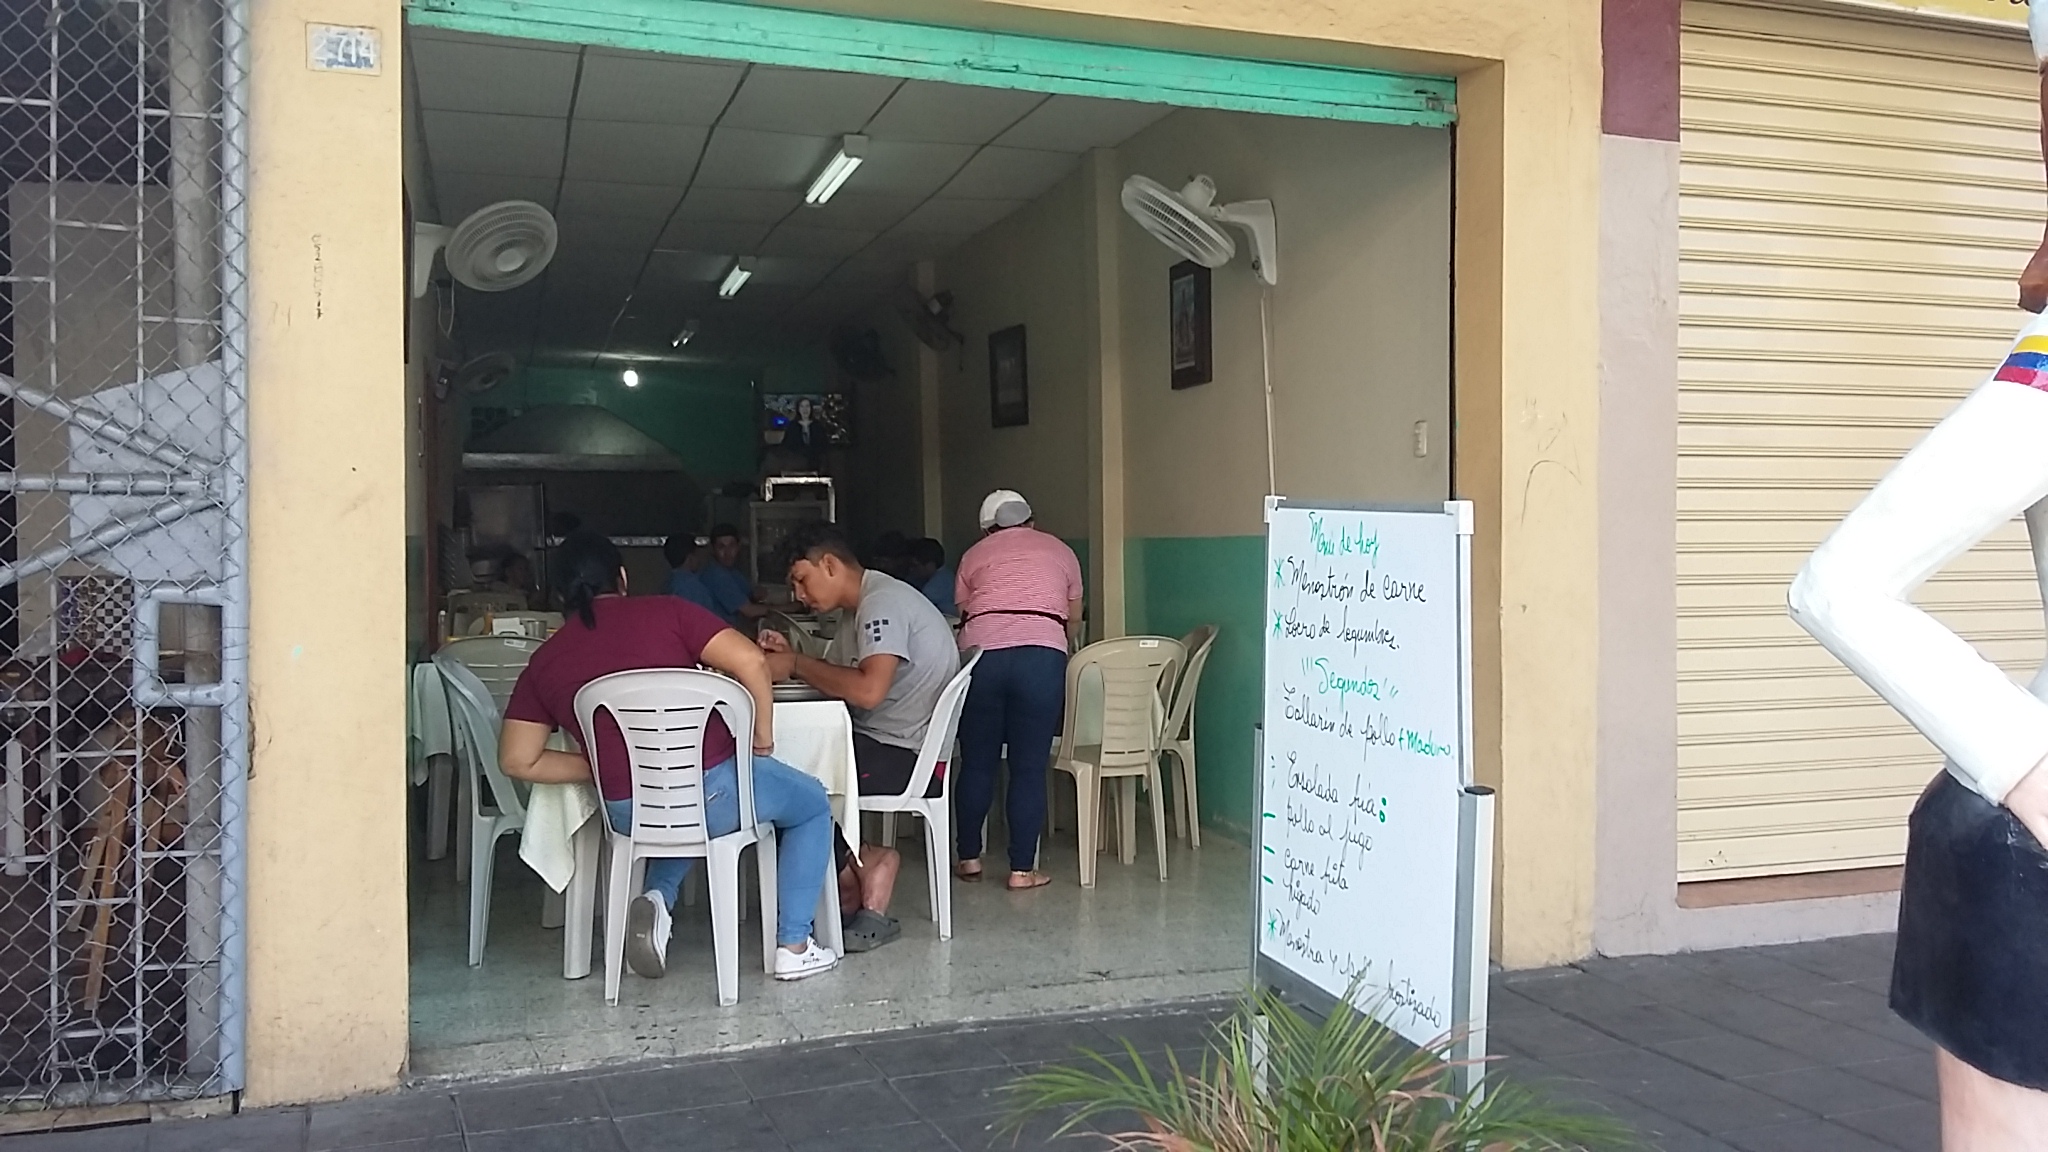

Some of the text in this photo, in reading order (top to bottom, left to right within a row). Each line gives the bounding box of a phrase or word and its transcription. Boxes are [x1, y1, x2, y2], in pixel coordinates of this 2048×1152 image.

[1339, 525, 1352, 556] de
[1354, 520, 1380, 569] hoy
[1360, 569, 1376, 602] de
[1319, 613, 1331, 637] de
[1339, 711, 1353, 739] de
[1319, 814, 1334, 841] al
